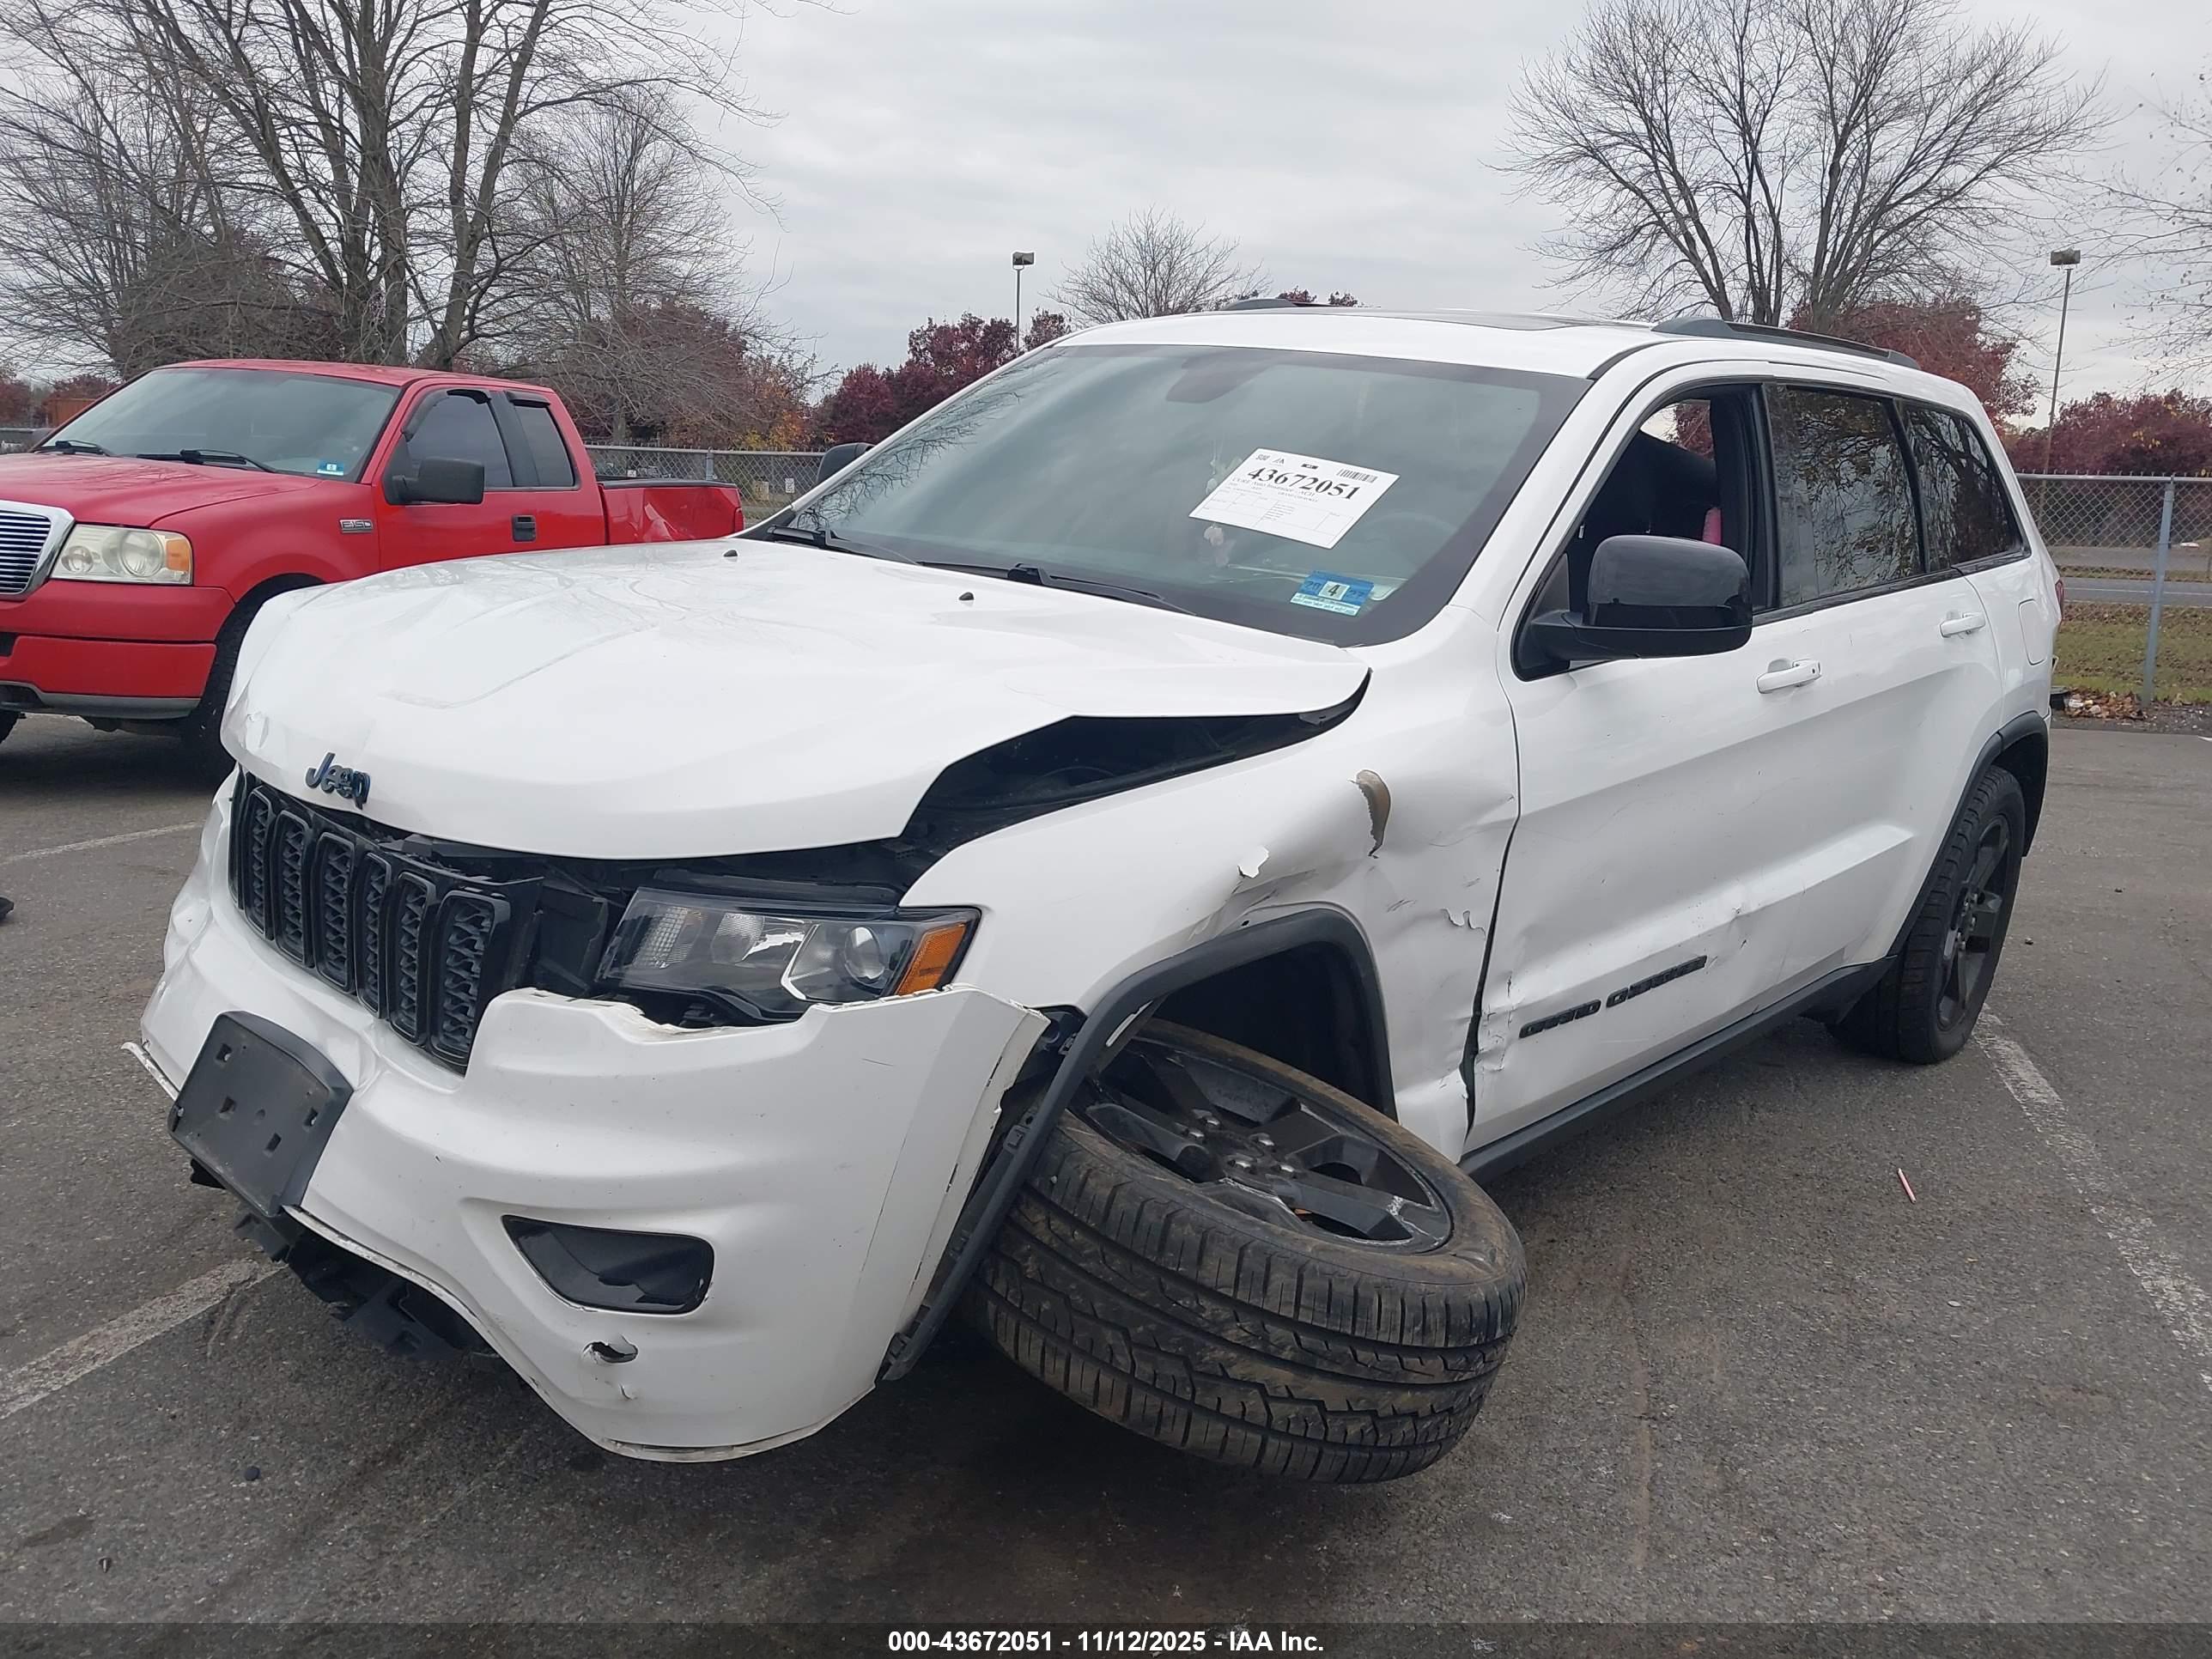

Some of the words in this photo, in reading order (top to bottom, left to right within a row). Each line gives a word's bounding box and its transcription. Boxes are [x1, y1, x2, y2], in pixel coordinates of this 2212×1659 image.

[1248, 467, 1361, 500] 43672051
[1328, 584, 1340, 597] 4
[305, 751, 371, 810] Jeep
